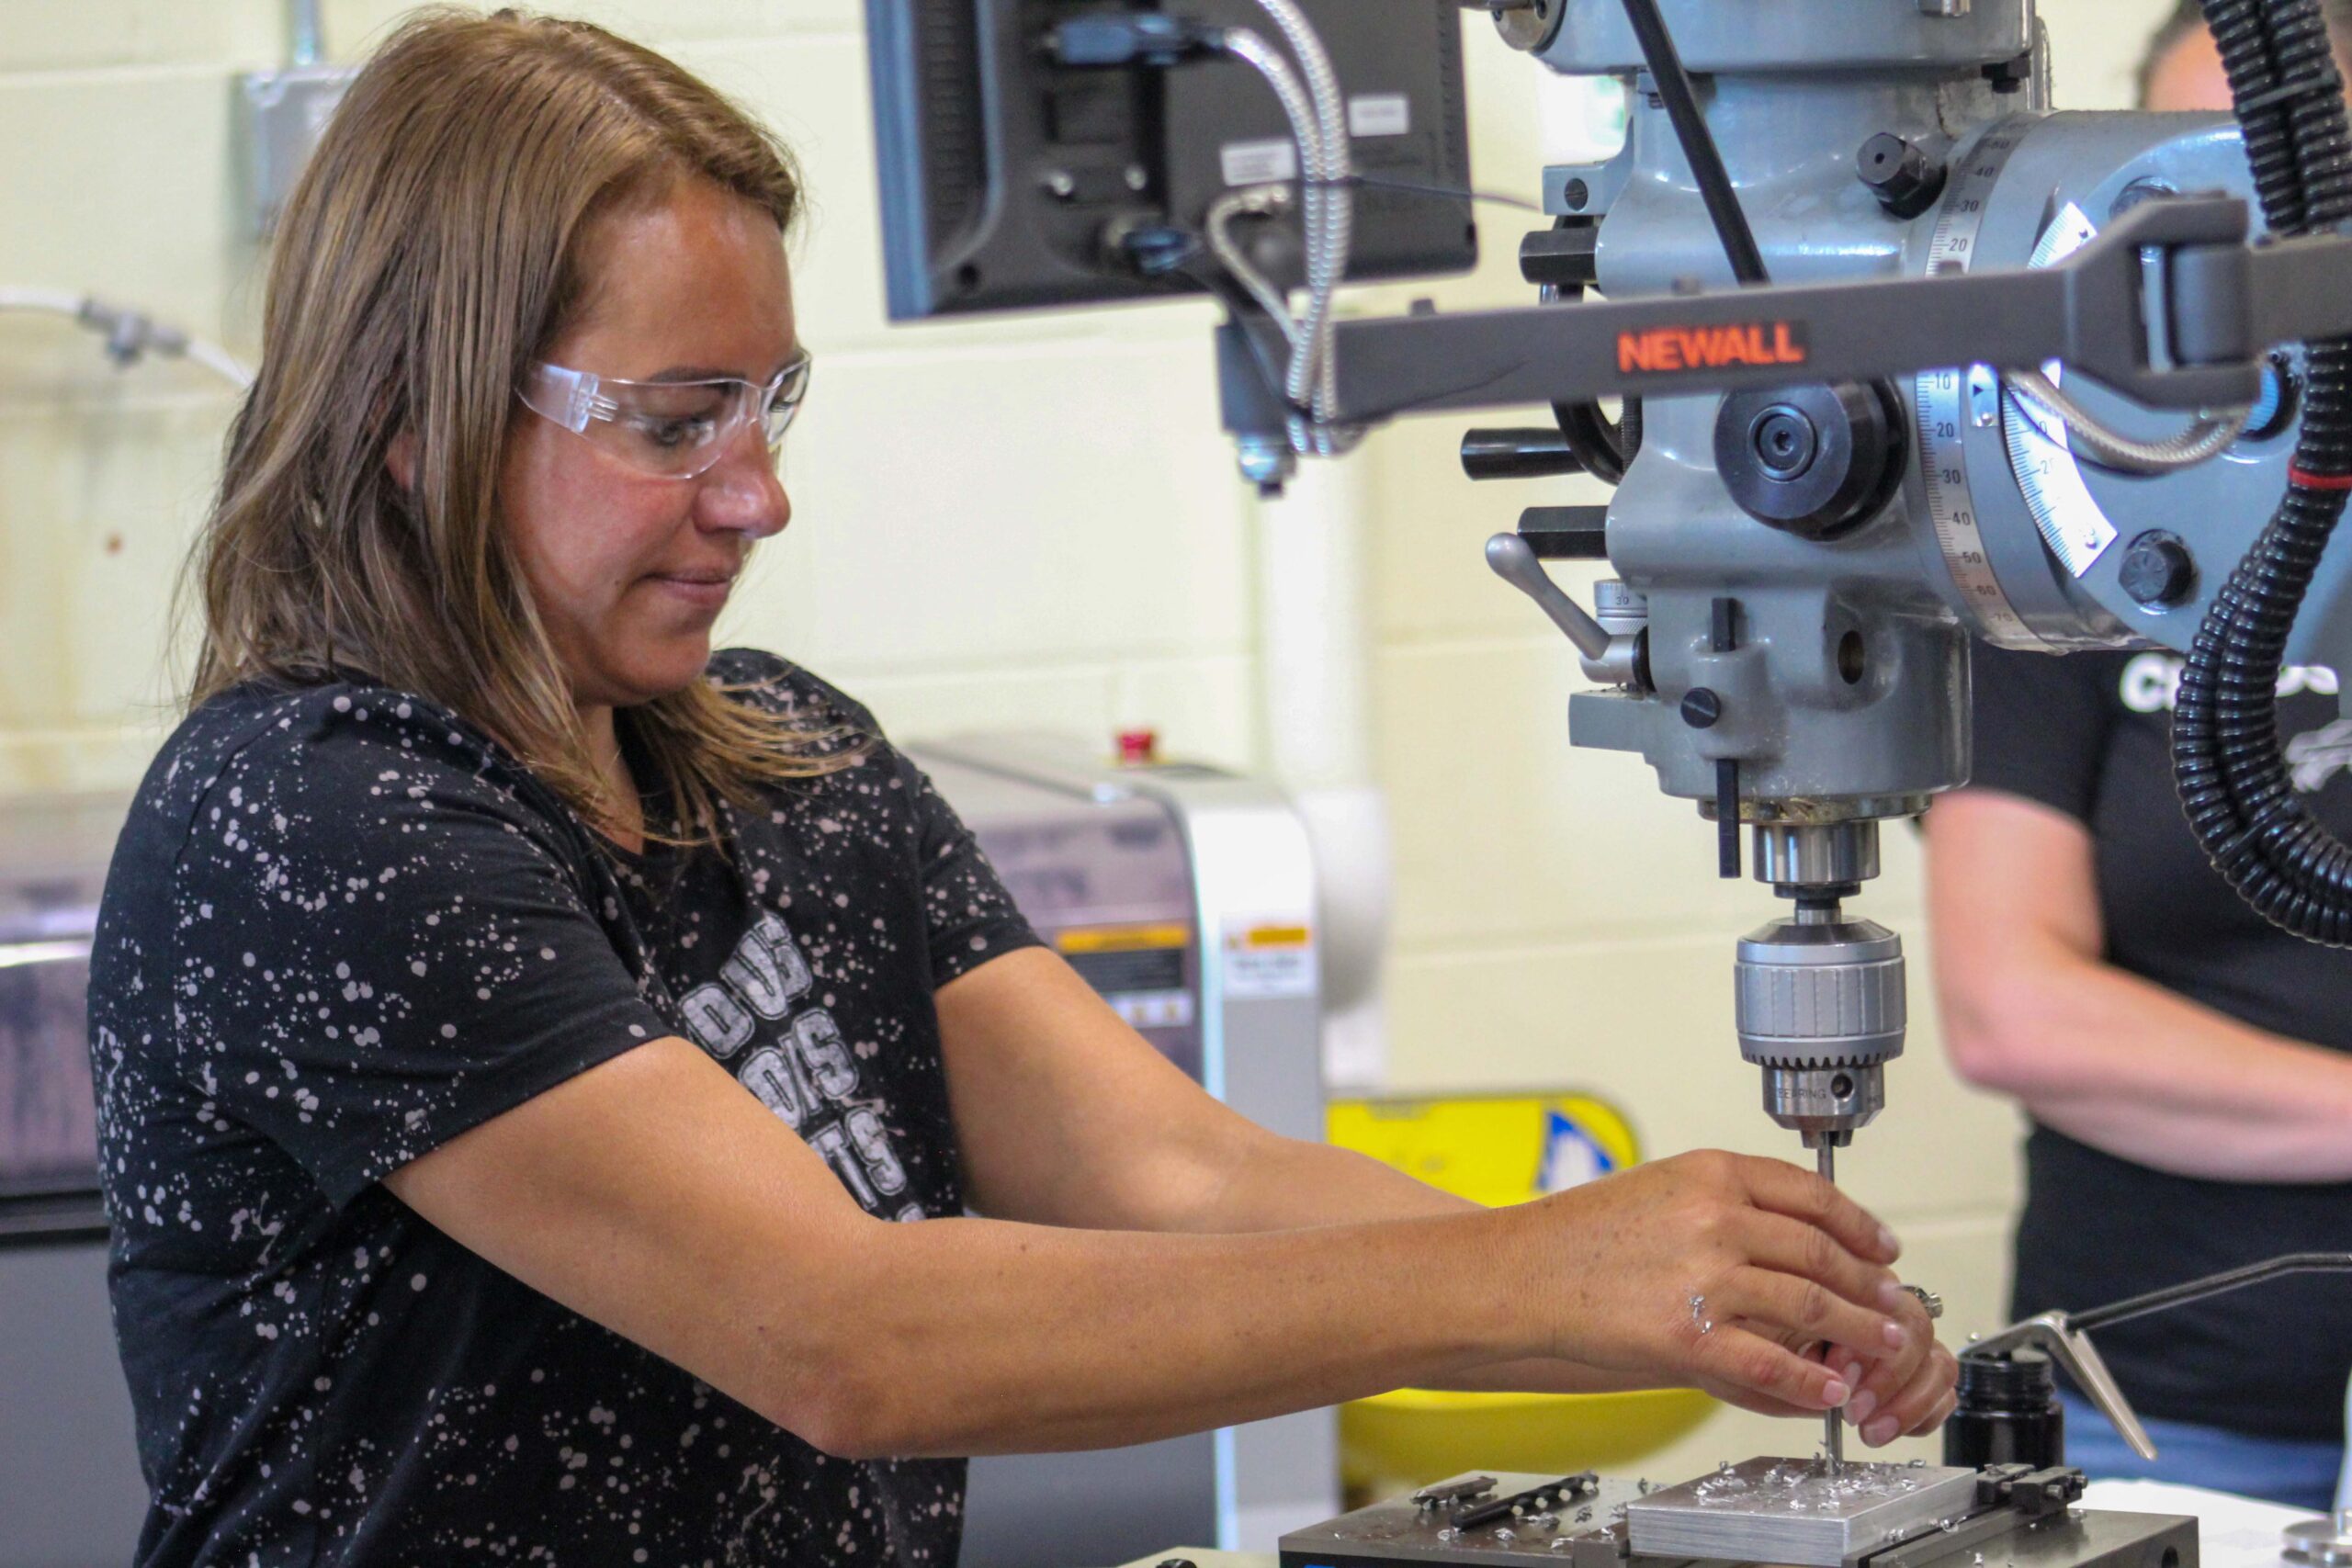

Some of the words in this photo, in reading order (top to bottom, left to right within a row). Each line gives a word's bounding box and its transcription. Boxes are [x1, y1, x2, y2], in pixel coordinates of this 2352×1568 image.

[1961, 199, 1979, 212] 30
[1949, 238, 1967, 253] 20
[1618, 321, 1804, 372] NEWALL
[1935, 372, 1951, 390] 10
[1936, 422, 1955, 438] 20
[1941, 469, 1962, 485] 30
[1951, 512, 1971, 526] 40
[1962, 551, 1983, 564] 50
